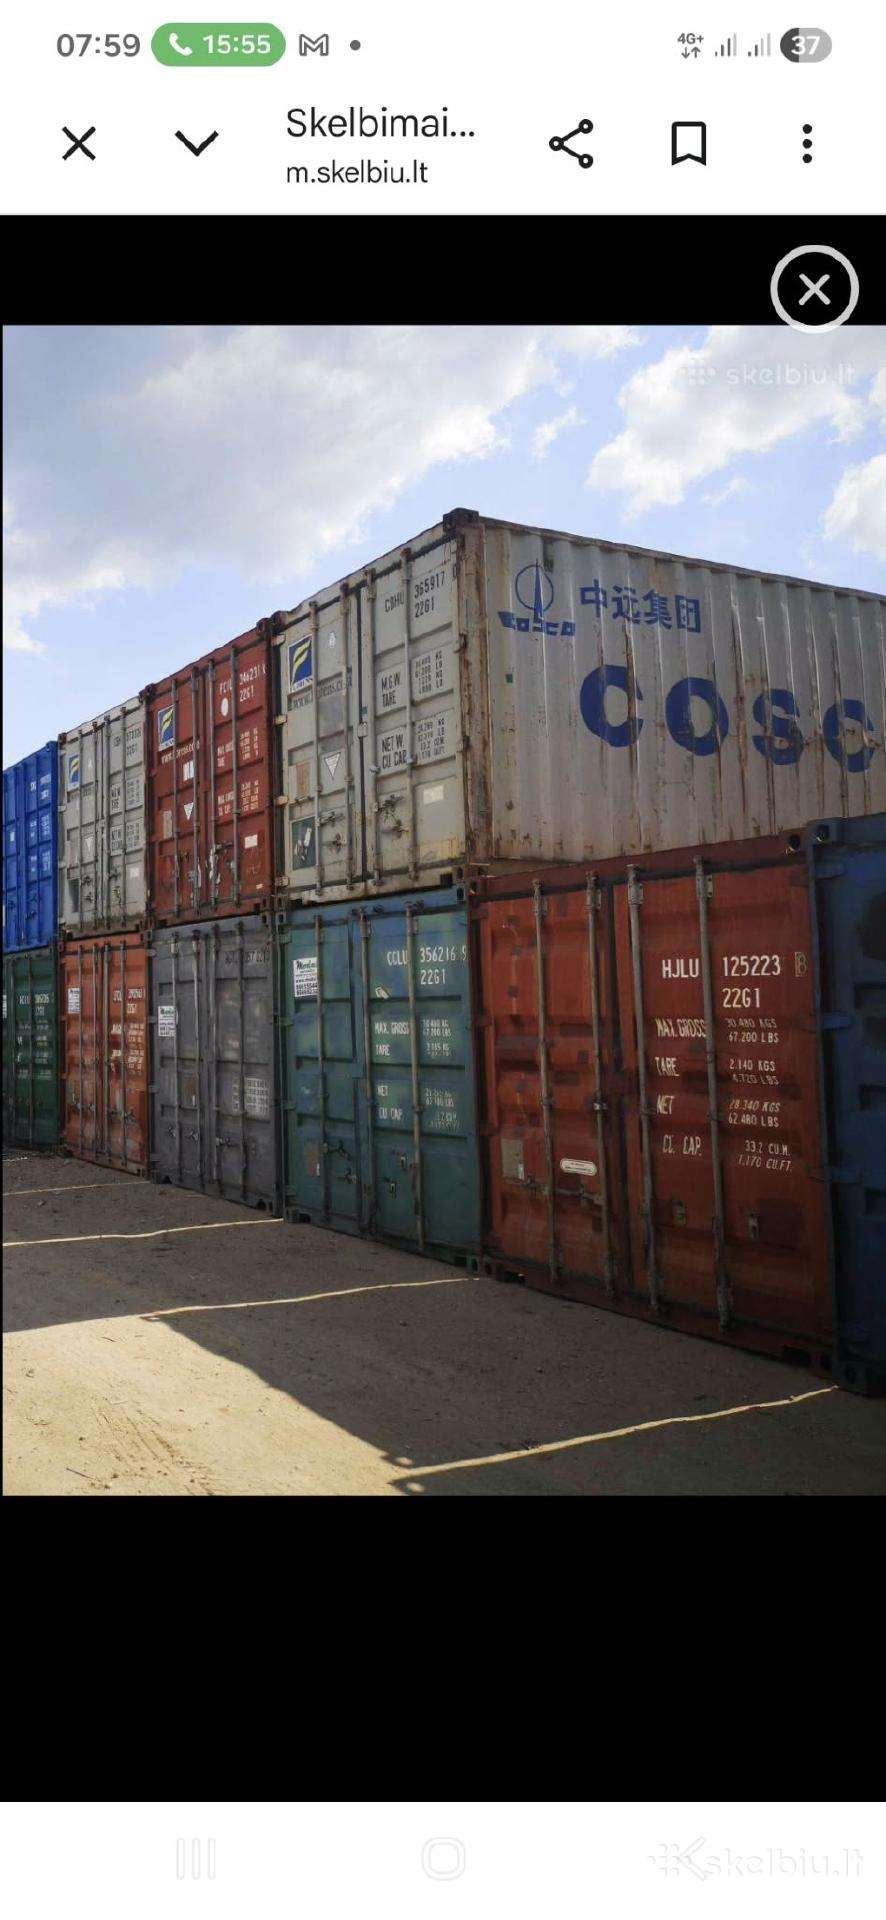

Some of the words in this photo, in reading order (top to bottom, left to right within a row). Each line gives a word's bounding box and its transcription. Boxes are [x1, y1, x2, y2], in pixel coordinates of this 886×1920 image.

[56, 33, 141, 58] 07:59
[202, 34, 272, 56] 15:55
[677, 33, 705, 45] 4G+
[790, 35, 820, 56] 37
[286, 107, 476, 140] Skelbimai...
[286, 160, 428, 184] m.skelbiu.lt
[414, 570, 445, 599] 365917
[580, 578, 701, 634] 中远集团
[580, 664, 876, 773] COSC
[386, 949, 409, 966] CCLU
[419, 945, 456, 963] 356216
[662, 958, 700, 978] HJLU
[722, 954, 781, 977] 125223
[722, 987, 760, 1008] 22G1
[728, 1031, 758, 1043] 67.200
[761, 1031, 780, 1043] LBS
[375, 1044, 391, 1057] TARE
[655, 1056, 680, 1077] TARE
[758, 1060, 777, 1072] KGS
[377, 1085, 389, 1097] NET
[657, 1094, 675, 1115] NET
[762, 1101, 781, 1113] KGS
[761, 1115, 780, 1128] LBS
[745, 1139, 763, 1154] 33.2
